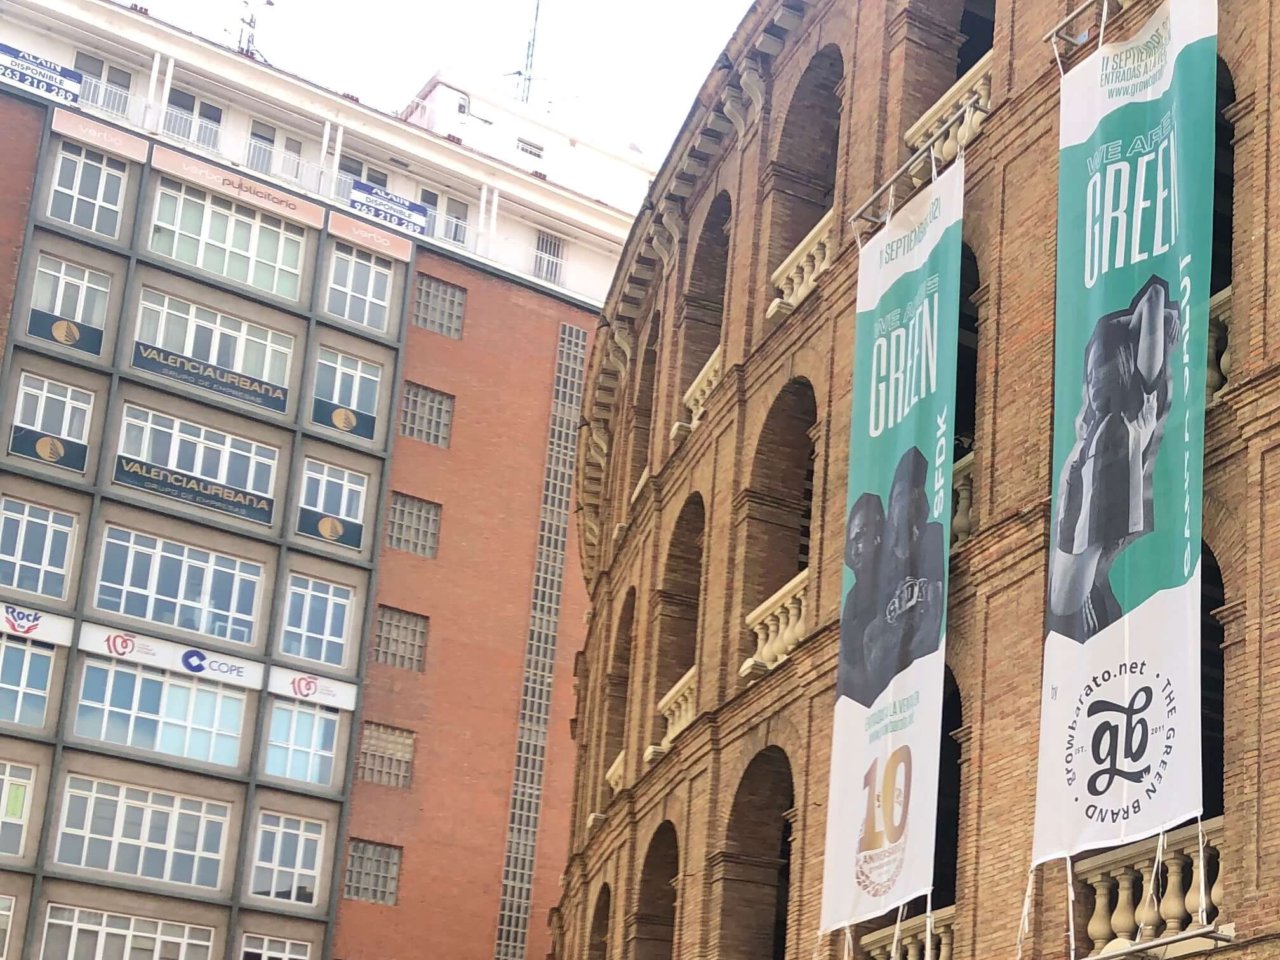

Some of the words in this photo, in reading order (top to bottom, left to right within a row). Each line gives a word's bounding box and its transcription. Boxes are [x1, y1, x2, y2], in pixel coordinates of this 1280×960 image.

[10, 59, 64, 87] DISPONIBLE
[24, 75, 47, 92] 210
[51, 84, 73, 102] 289
[1100, 64, 1142, 87] ENTRADAS
[1087, 140, 1122, 176] WE
[354, 202, 375, 216] 963
[378, 211, 399, 226] 210
[401, 219, 421, 234] 289
[1084, 121, 1179, 289] GREEN
[868, 292, 939, 438] GREEN
[208, 660, 245, 678] COPE
[1161, 678, 1177, 719] THE
[1065, 660, 1147, 787] growbarato.net
[1150, 724, 1165, 735] 2011
[1145, 727, 1176, 800] GREEN
[858, 744, 912, 855] 10
[1085, 799, 1142, 824] BRAND
